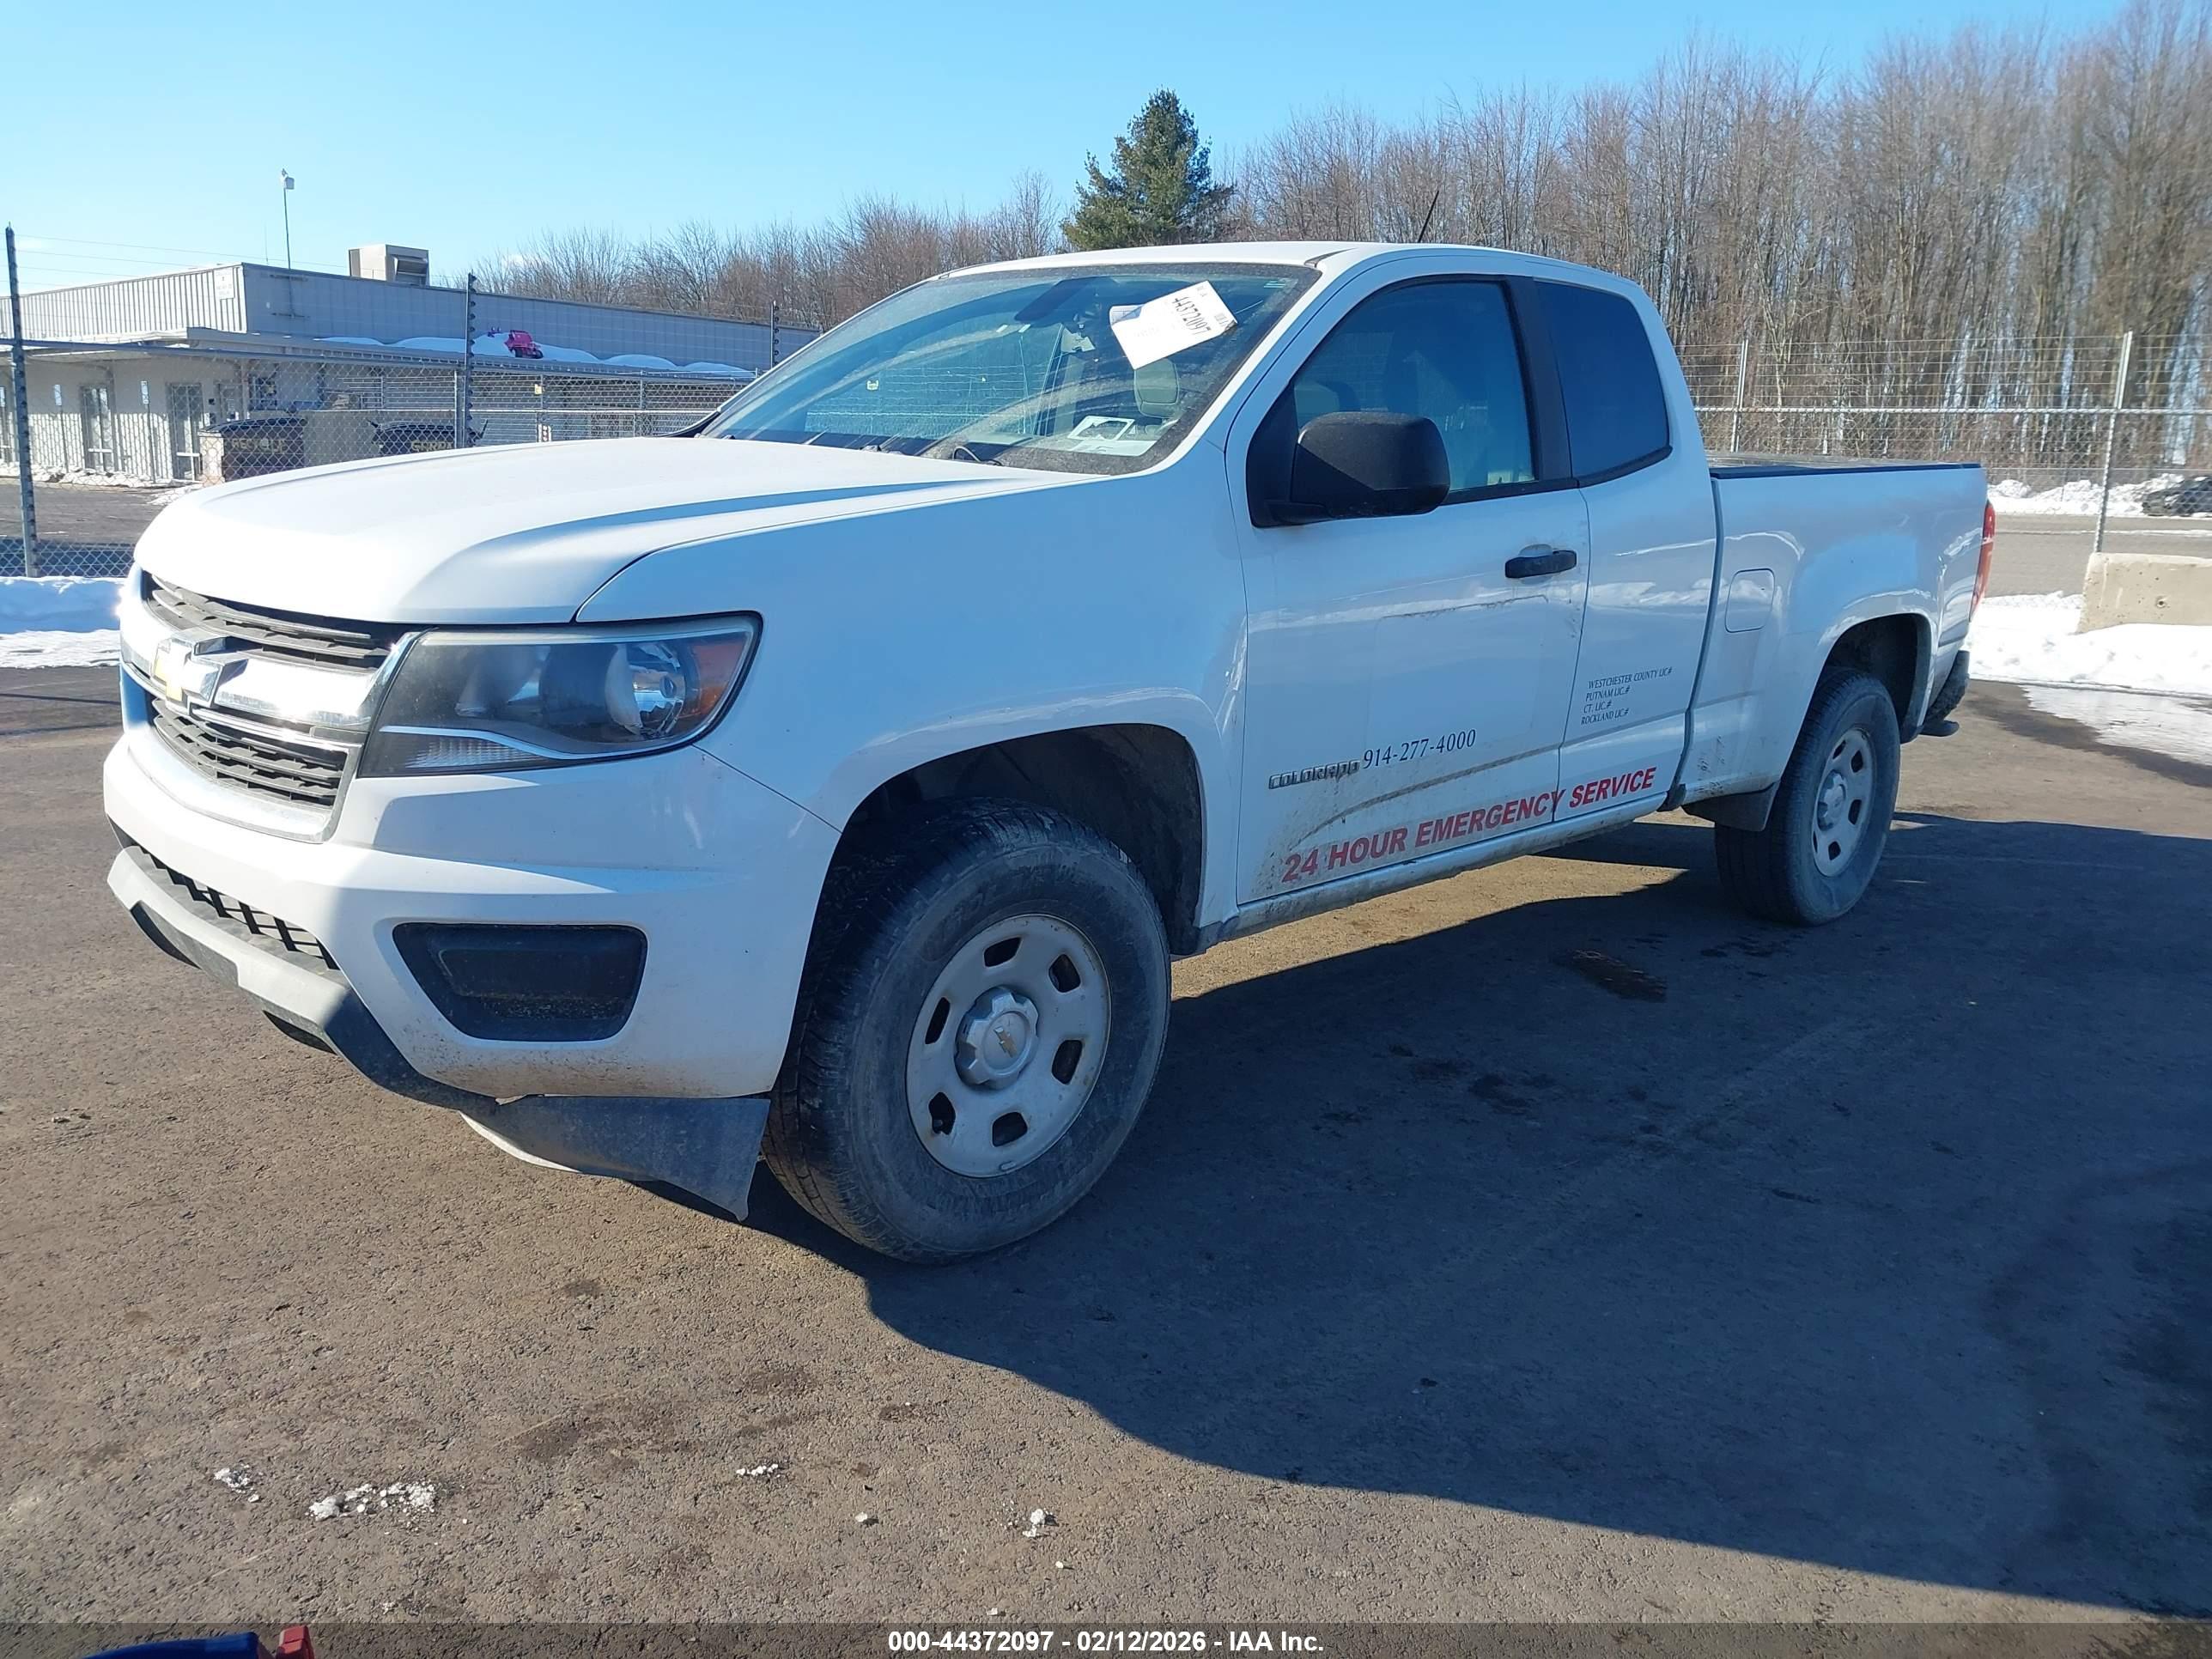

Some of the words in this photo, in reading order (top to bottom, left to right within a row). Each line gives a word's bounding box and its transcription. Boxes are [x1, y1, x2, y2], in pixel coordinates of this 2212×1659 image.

[1171, 295, 1212, 336] 44372097
[1589, 673, 1632, 689] WESTCHESTER
[1633, 670, 1657, 682] COUNTY
[1585, 690, 1614, 702] PUTNAM
[1581, 711, 1614, 726] ROCKLAND
[1363, 729, 1476, 769] 914-277-4000
[1268, 759, 1360, 789] COLORADO
[1282, 849, 1319, 884] 24
[1328, 827, 1408, 871] HOUR
[1415, 789, 1565, 848] EMERGENCY
[1569, 766, 1657, 808] SERVICE
